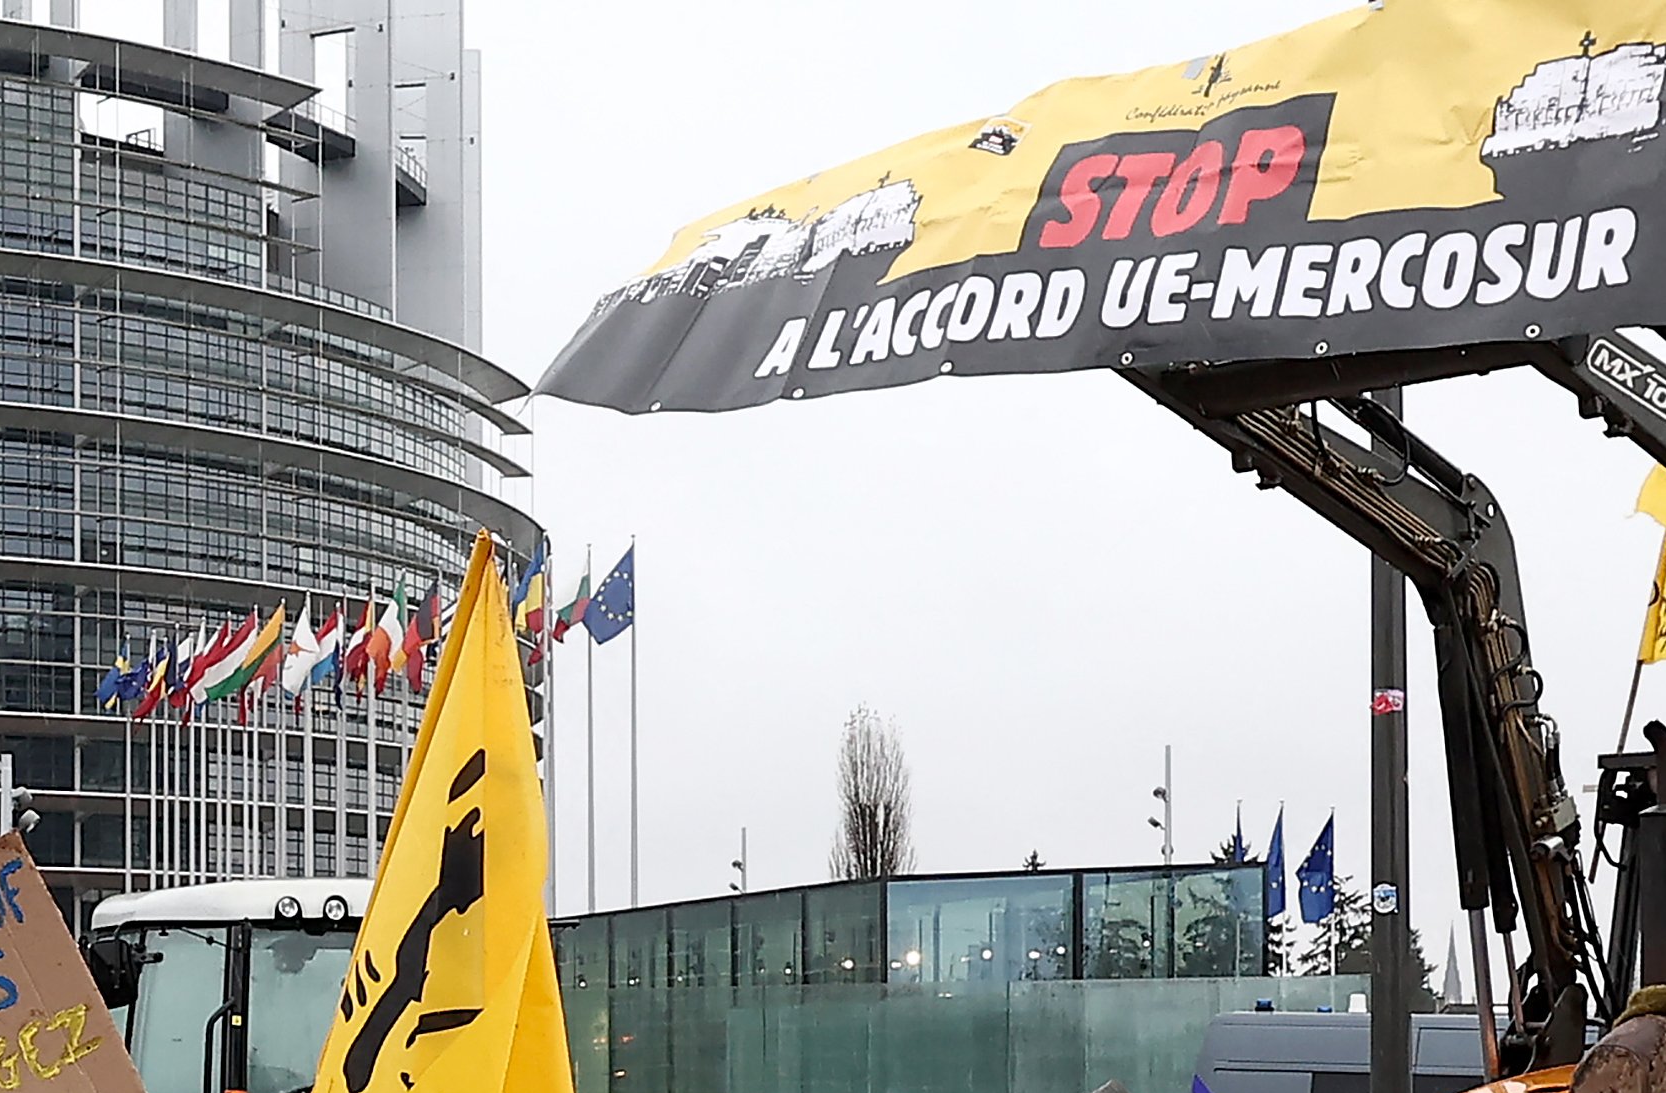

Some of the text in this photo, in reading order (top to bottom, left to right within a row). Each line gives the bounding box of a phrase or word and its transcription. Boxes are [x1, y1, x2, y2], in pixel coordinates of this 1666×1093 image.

[1038, 125, 1307, 249] STOP
[755, 206, 1638, 378] A L'ACCORD UE-MERCOSUR
[1594, 348, 1655, 388] MX
